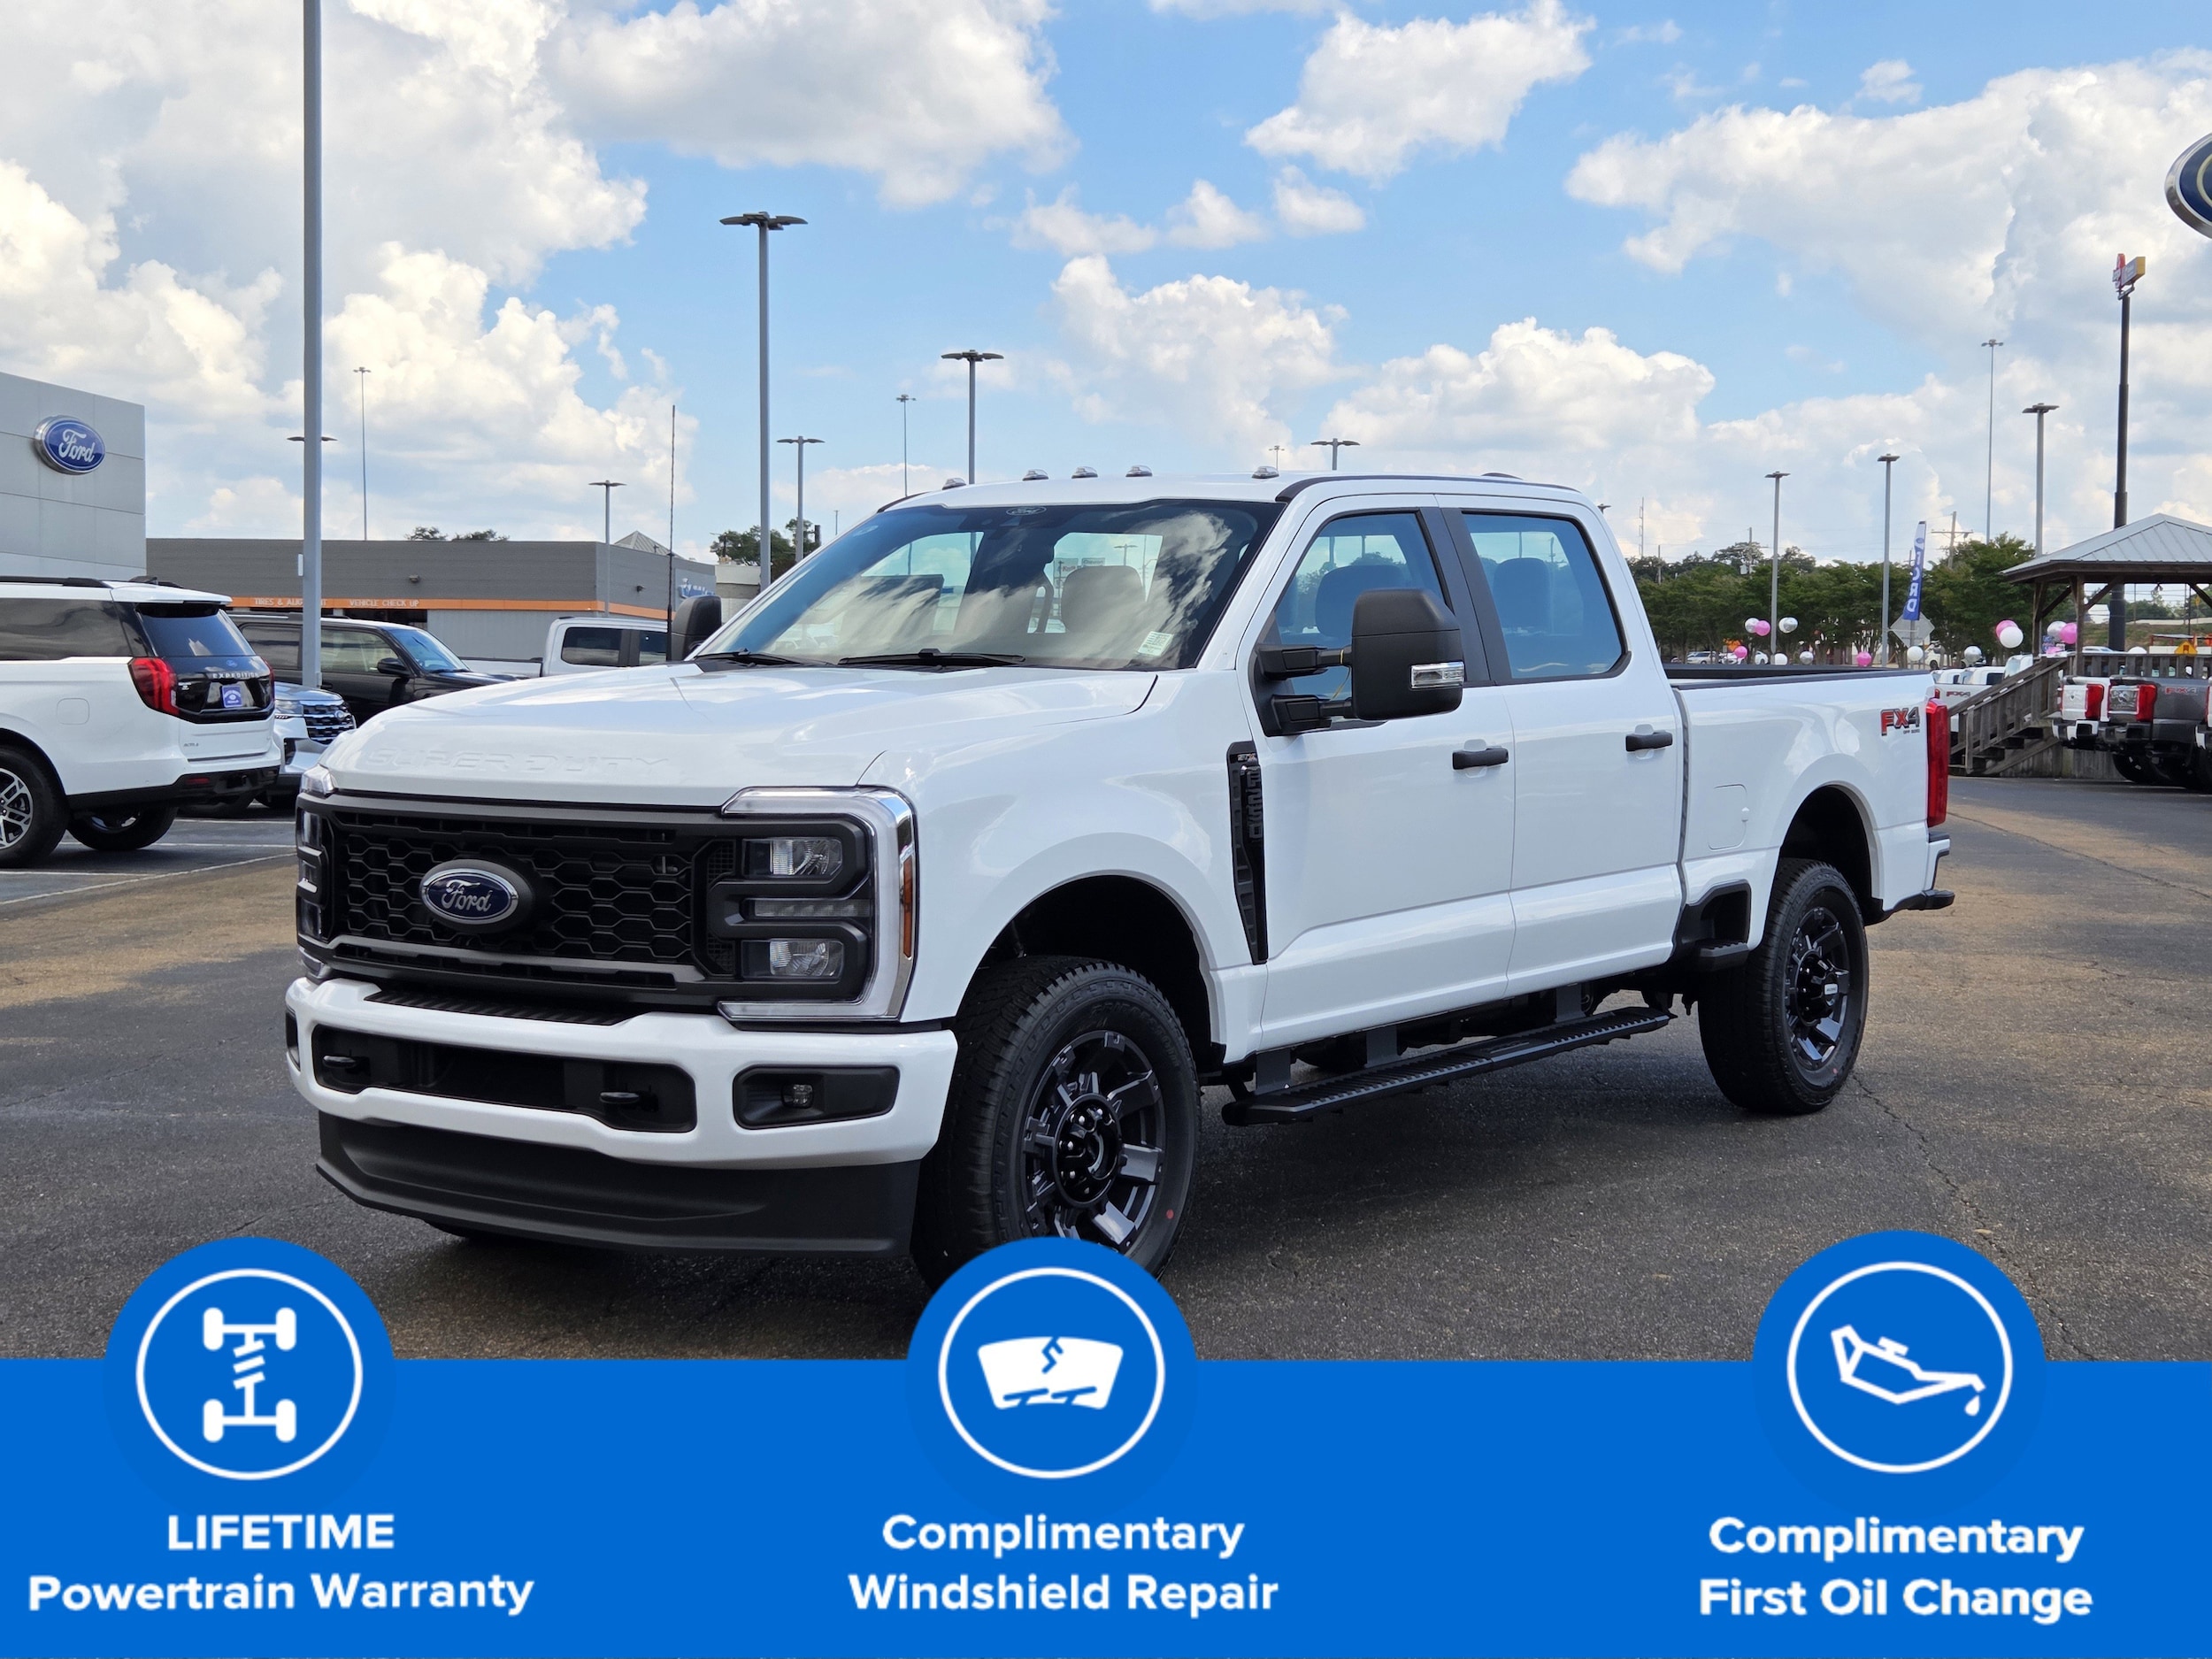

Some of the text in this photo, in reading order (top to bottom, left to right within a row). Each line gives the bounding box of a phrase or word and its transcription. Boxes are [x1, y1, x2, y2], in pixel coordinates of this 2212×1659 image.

[58, 428, 96, 463] Ford
[1880, 706, 1920, 736] FX4
[365, 749, 669, 772] SUPER DUTY
[442, 879, 493, 912] Ford
